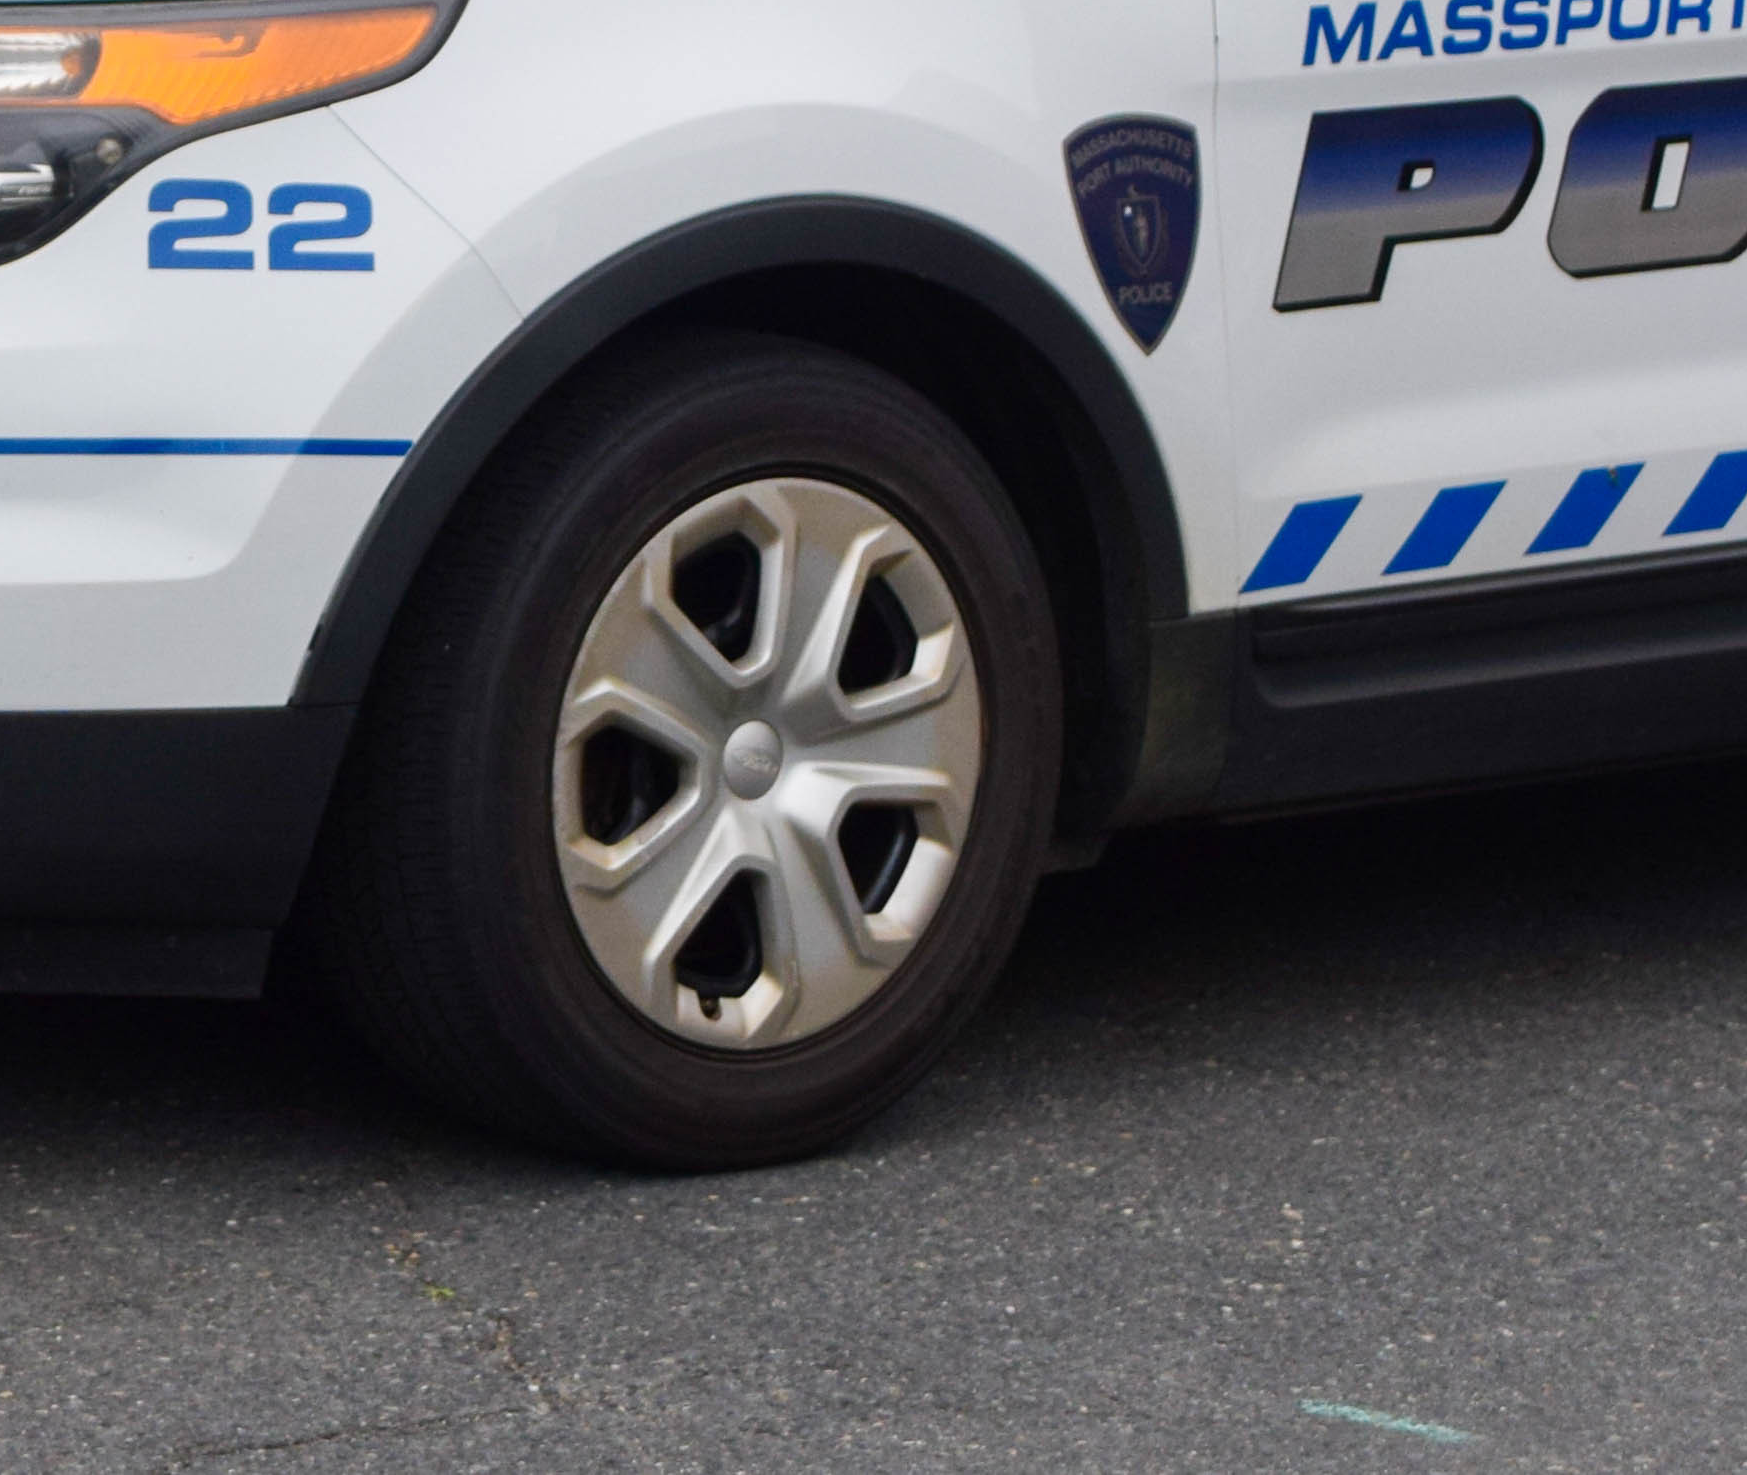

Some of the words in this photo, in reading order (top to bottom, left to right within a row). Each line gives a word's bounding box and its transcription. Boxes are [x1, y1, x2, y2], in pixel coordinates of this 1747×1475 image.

[1071, 129, 1193, 169] MASSACHUSETTS
[1077, 163, 1111, 197] PORT
[1114, 154, 1194, 187] AUTHORITY
[147, 178, 375, 272] 22
[1118, 281, 1173, 306] POLICE
